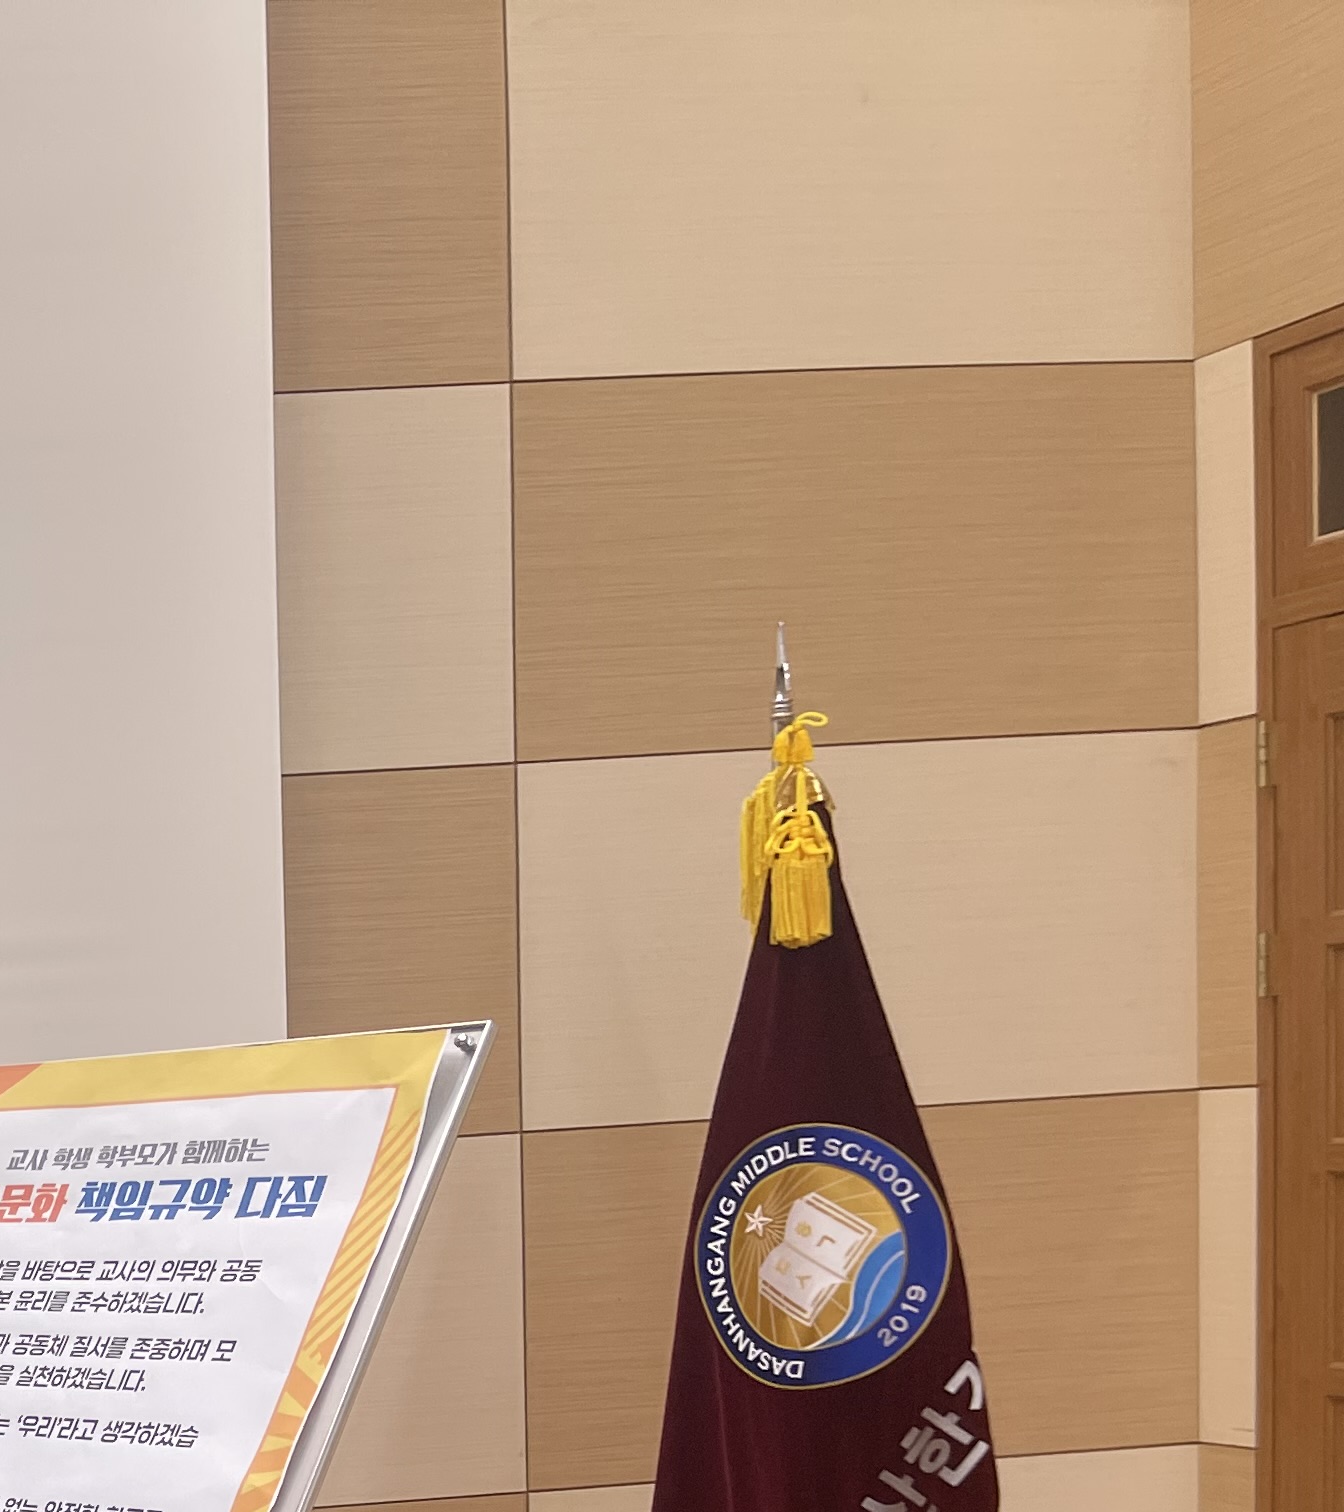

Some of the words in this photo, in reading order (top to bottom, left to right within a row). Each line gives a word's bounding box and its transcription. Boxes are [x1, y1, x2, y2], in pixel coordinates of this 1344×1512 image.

[6, 1149, 48, 1171] 교사
[52, 1147, 90, 1170] 학생
[96, 1142, 178, 1168] 학부모가
[181, 1138, 270, 1165] 함께하는
[730, 1137, 816, 1197] MIDDLE
[821, 1137, 922, 1214] SCHOOL
[74, 1177, 233, 1222] 책임규약
[233, 1175, 328, 1220] 다짐
[21, 1260, 96, 1281] 바탕으로
[96, 1260, 156, 1282] 교사의
[157, 1260, 217, 1283] 의무와
[219, 1259, 263, 1282] 공동
[707, 1195, 806, 1380] DASANHANGANG
[14, 1290, 70, 1312] 윤리를
[70, 1292, 205, 1315] 준수하겠습니다.
[877, 1284, 928, 1348] 2019
[12, 1334, 67, 1357] 공동체
[69, 1336, 128, 1358] 질서를
[129, 1337, 210, 1362] 존중하며
[211, 1339, 237, 1363] 모
[15, 1364, 147, 1392] 실천하겠습니다.
[100, 1420, 199, 1449] 생각하겠습
